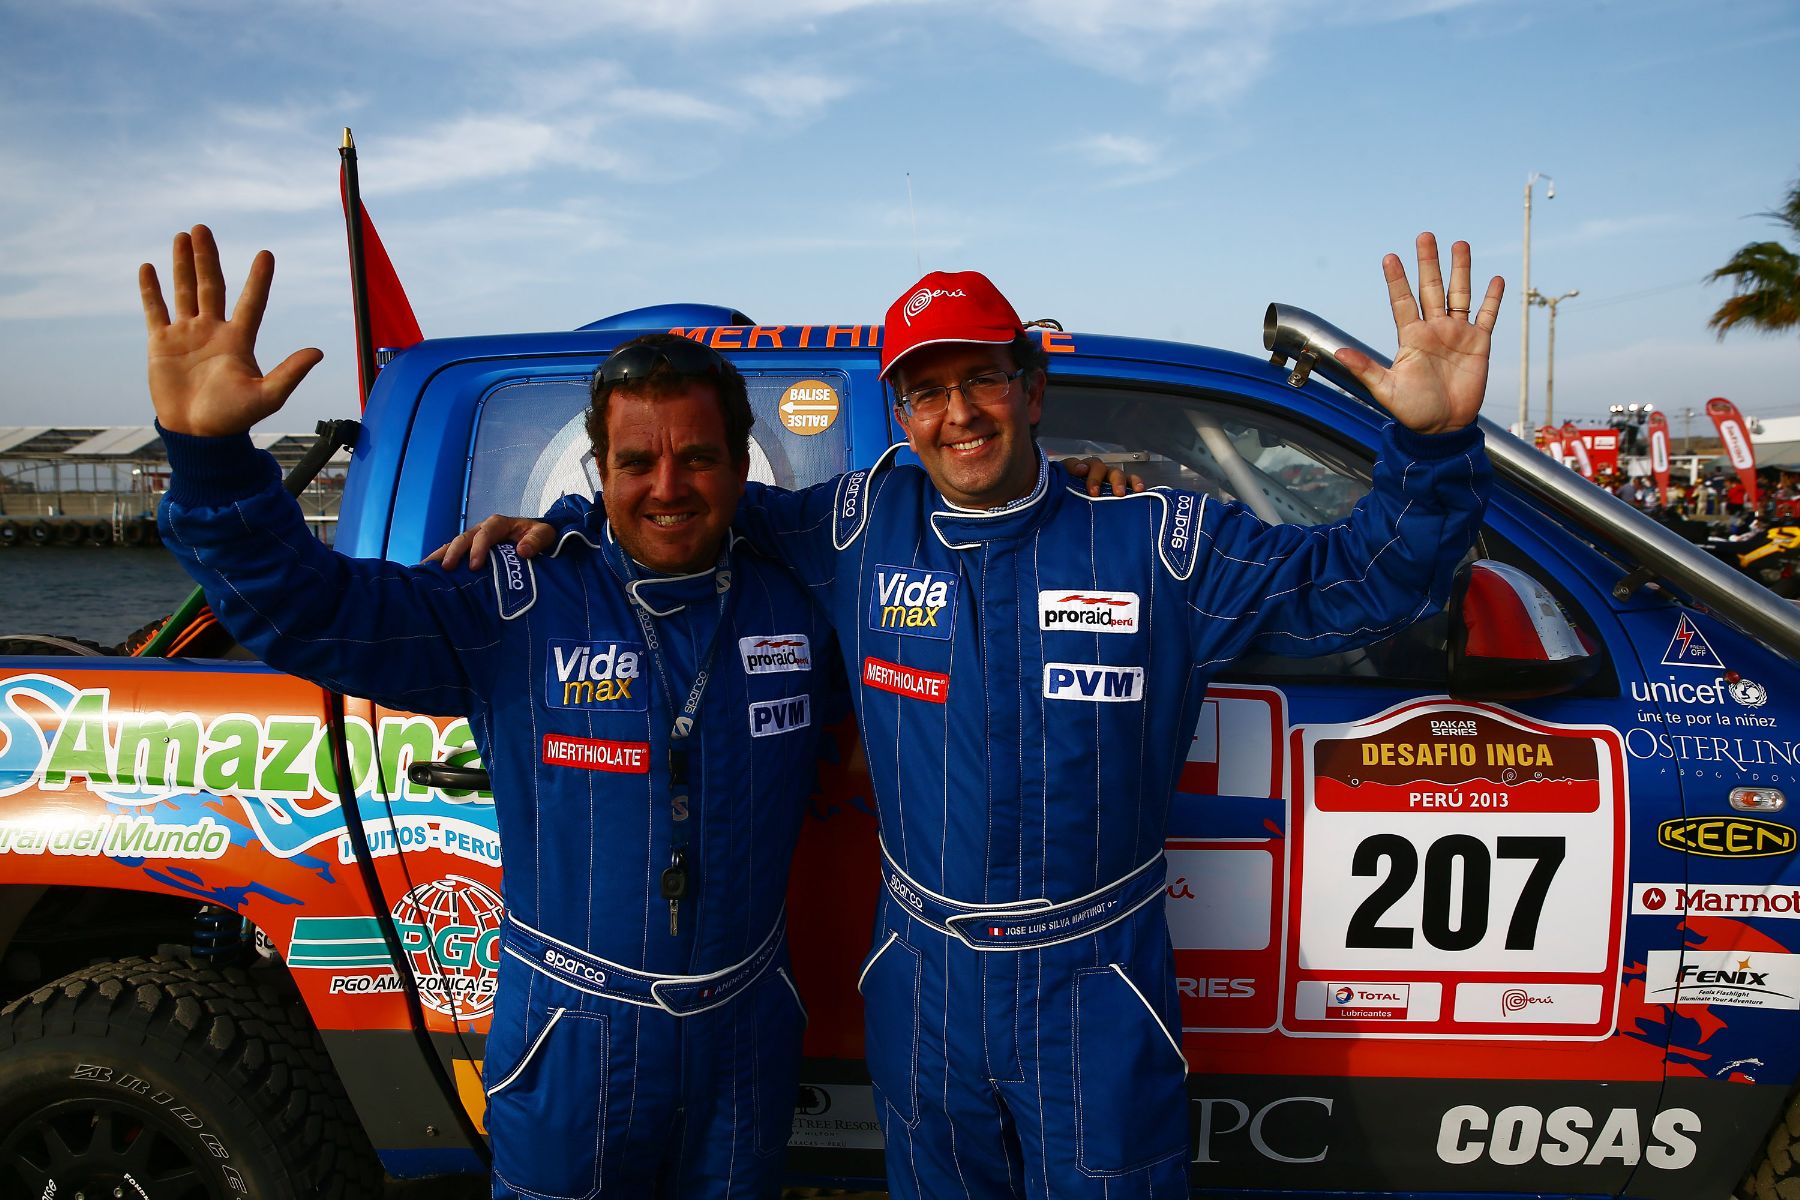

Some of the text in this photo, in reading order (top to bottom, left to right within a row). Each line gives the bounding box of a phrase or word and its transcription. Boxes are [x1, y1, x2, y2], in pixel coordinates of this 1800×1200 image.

[904, 288, 967, 327] Perú
[789, 389, 831, 402] BALISE
[788, 414, 829, 428] BALISE
[845, 472, 866, 518] sparco
[1171, 495, 1192, 550] sparco
[500, 544, 524, 590] sparco
[878, 572, 949, 608] Vida
[636, 607, 659, 651] sparco
[881, 605, 940, 628] max
[1044, 607, 1112, 627] proraid
[553, 644, 639, 681] Vida
[747, 649, 797, 671] proraid
[1691, 649, 1707, 657] OFF
[563, 677, 634, 705] max
[684, 670, 709, 715] sparco
[866, 663, 942, 697] MERTHIOLATE
[1049, 669, 1135, 697] PVM
[1631, 675, 1725, 705] unicef
[753, 701, 808, 733] PVM
[1430, 719, 1477, 729] DAKAR
[1686, 714, 1712, 727] por
[1716, 713, 1731, 726] la
[1735, 713, 1777, 728] niñez
[1431, 728, 1478, 736] SERIES
[547, 740, 642, 767] MERTHIOLATE
[1361, 743, 1554, 766] DESAFIO INCA
[1409, 789, 1509, 808] PERÚ 2013
[0, 822, 46, 848] ral
[108, 821, 225, 853] Mundo
[344, 825, 427, 858] IUITOS
[445, 829, 500, 861] PERÚ
[1664, 821, 1789, 852] KEEN
[890, 874, 924, 910] sparco
[1345, 833, 1566, 951] 207
[1675, 888, 1800, 914] Marmot
[1005, 927, 1027, 936] JOSE
[1028, 923, 1047, 934] LUIS
[1049, 918, 1070, 930] SILVA
[543, 949, 606, 987] sparco
[1675, 965, 1770, 986] FENIX
[333, 978, 371, 992] PGO
[373, 977, 476, 992] AMZONICA
[1175, 977, 1256, 998] RIES
[1357, 991, 1401, 1001] TOTAL
[1716, 990, 1750, 998] Flashlight
[1341, 1008, 1392, 1018] Lubricantes
[1502, 988, 1554, 1017] Perú
[69, 1063, 248, 1200] BRIDGE
[1436, 1104, 1702, 1170] COSAS
